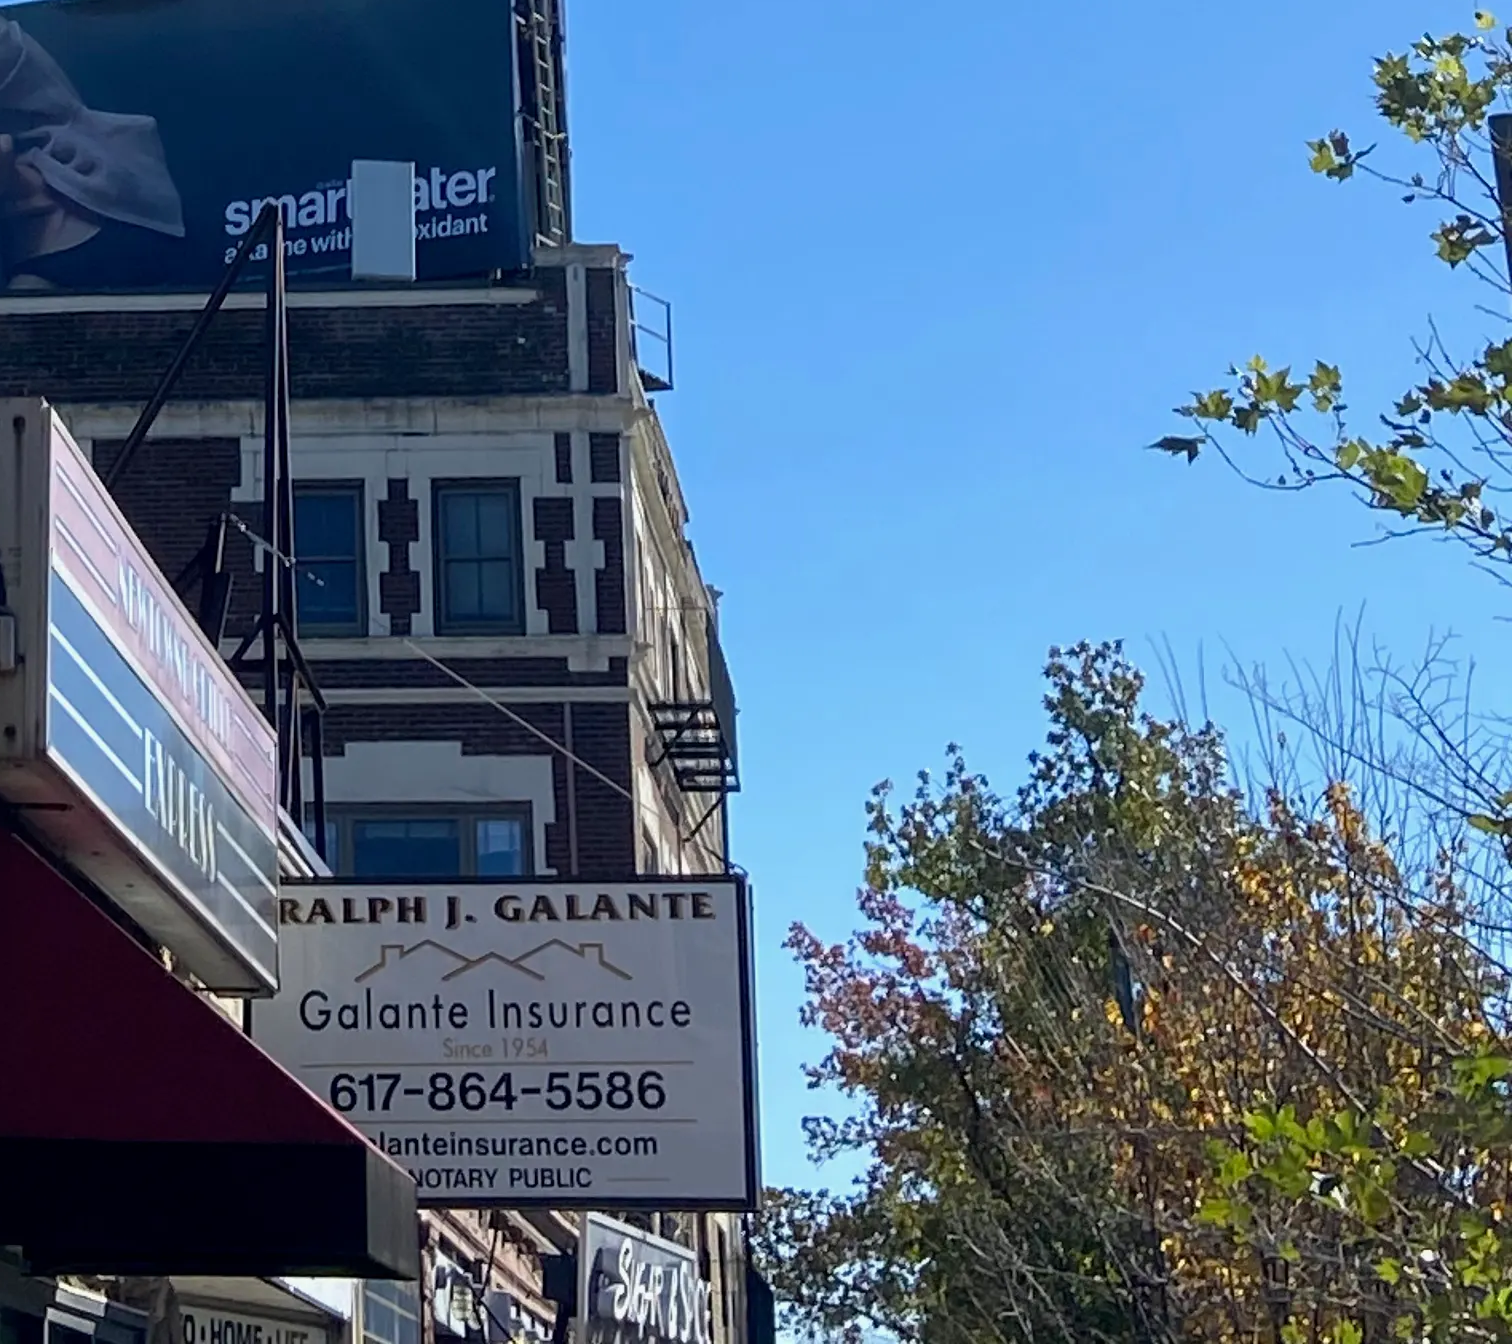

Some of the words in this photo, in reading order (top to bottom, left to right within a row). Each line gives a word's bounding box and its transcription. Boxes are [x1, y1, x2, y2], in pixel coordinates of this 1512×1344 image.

[144, 727, 218, 884] EXPRESS
[280, 896, 426, 924] RALPH
[445, 895, 477, 929] J.
[494, 892, 715, 922] GALANTE
[299, 990, 469, 1031] Galante
[488, 989, 691, 1030] Insurance
[442, 1039, 493, 1058] Since
[501, 1038, 549, 1058] 1954
[329, 1070, 666, 1111] 617-864-5586
[368, 1131, 658, 1157] lanteinsurance.com
[509, 1168, 593, 1189] PUBLIC
